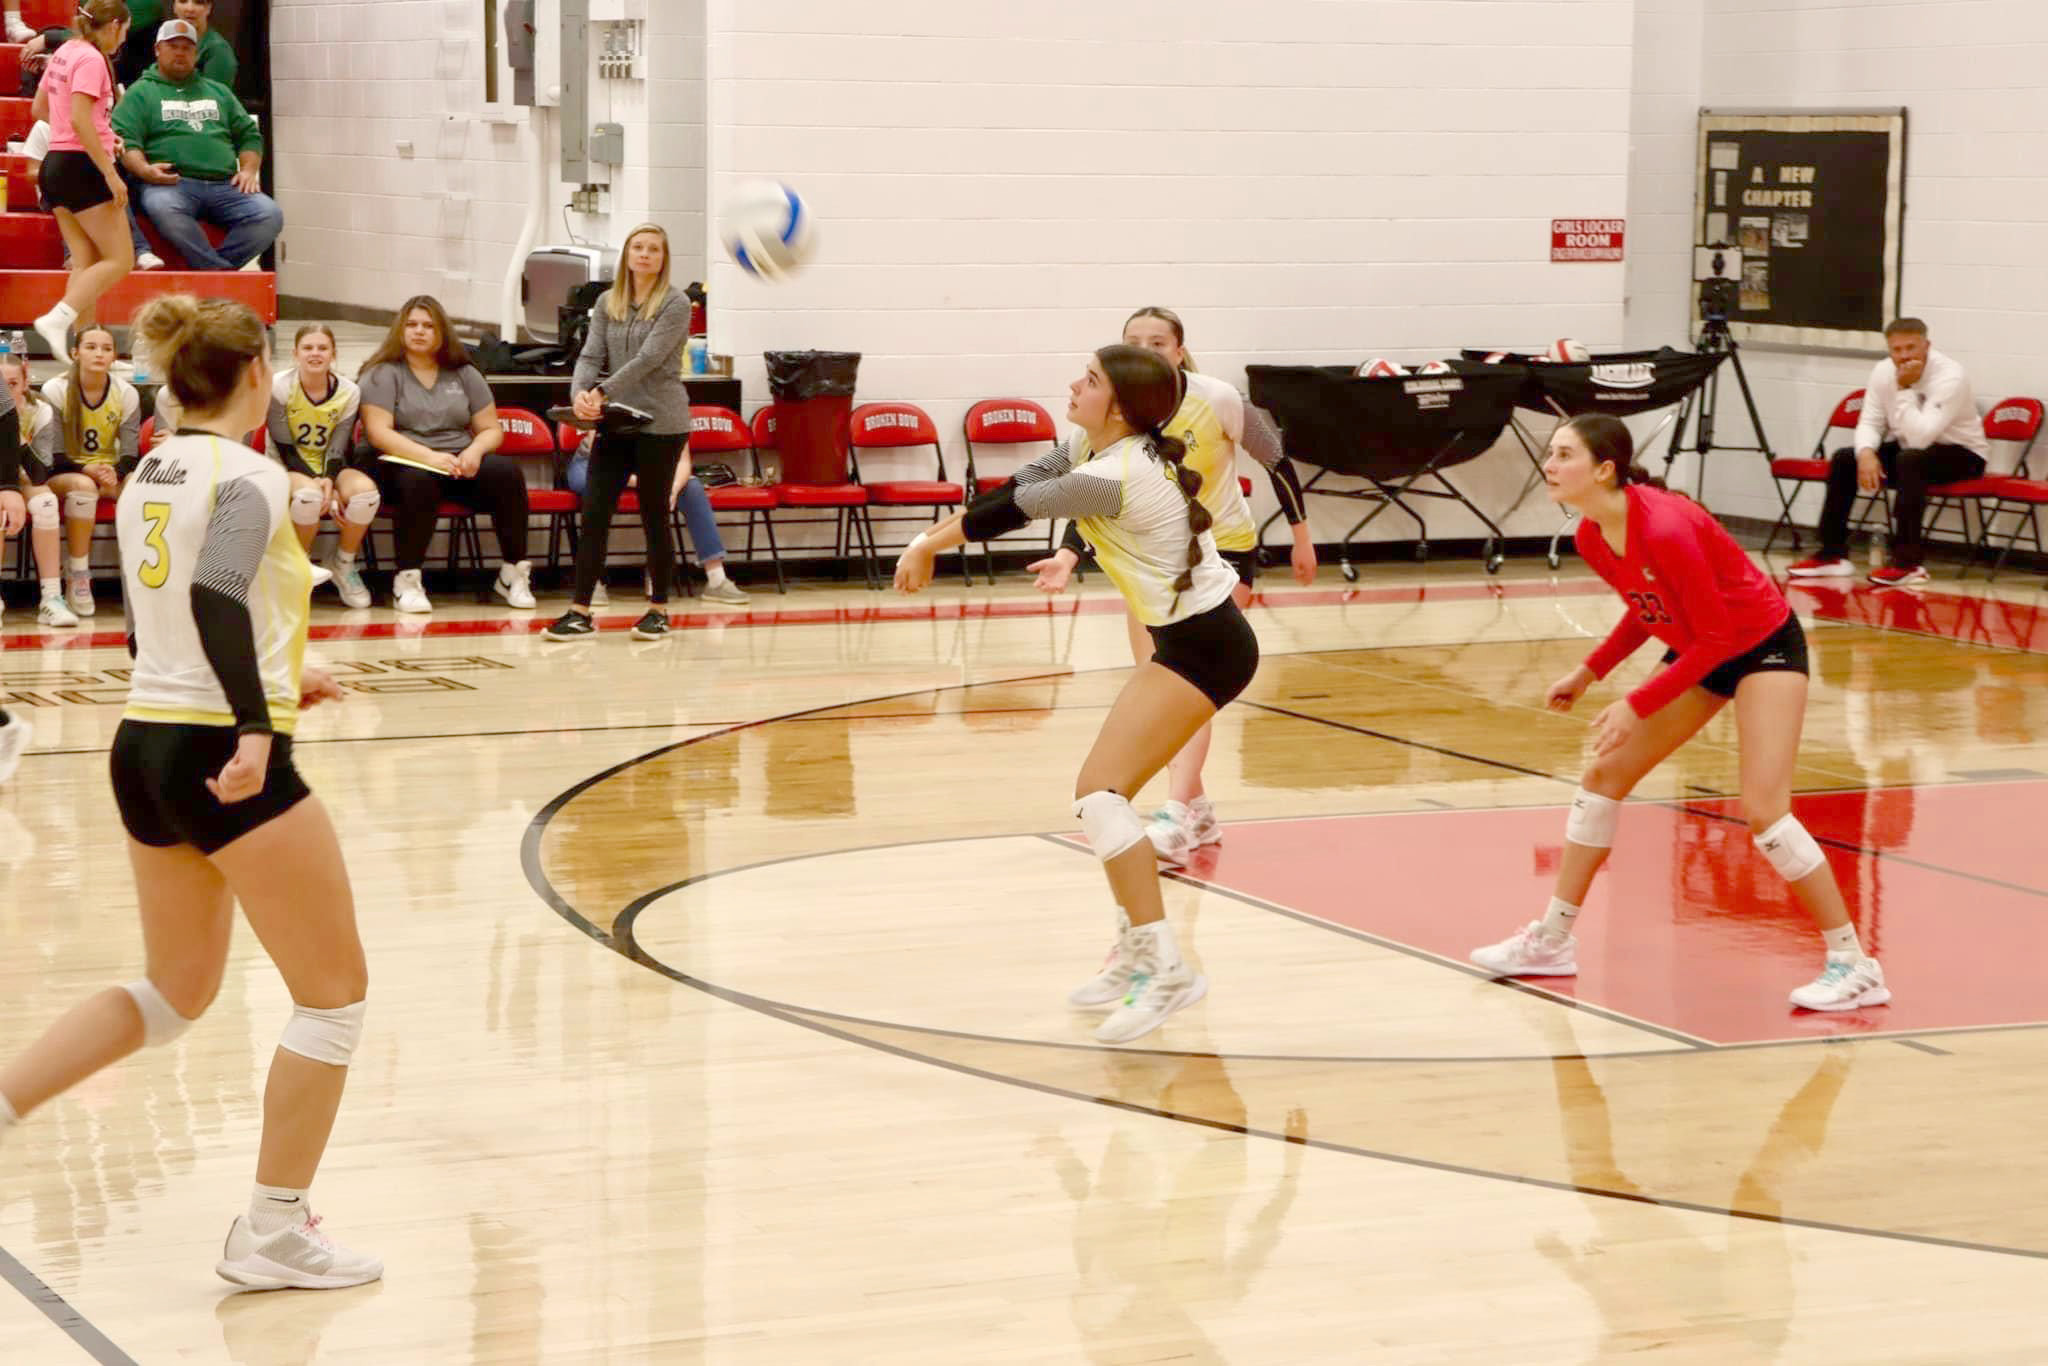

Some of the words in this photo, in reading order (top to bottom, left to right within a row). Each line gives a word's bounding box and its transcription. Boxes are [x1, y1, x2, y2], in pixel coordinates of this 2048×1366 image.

[1752, 166, 1764, 183] A
[1779, 166, 1816, 183] NEW
[1742, 189, 1812, 207] CHAPTER
[1565, 234, 1611, 247] ROOM
[297, 423, 328, 447] 23
[511, 418, 533, 435] BOW
[84, 429, 99, 452] 8
[137, 501, 171, 589] 3
